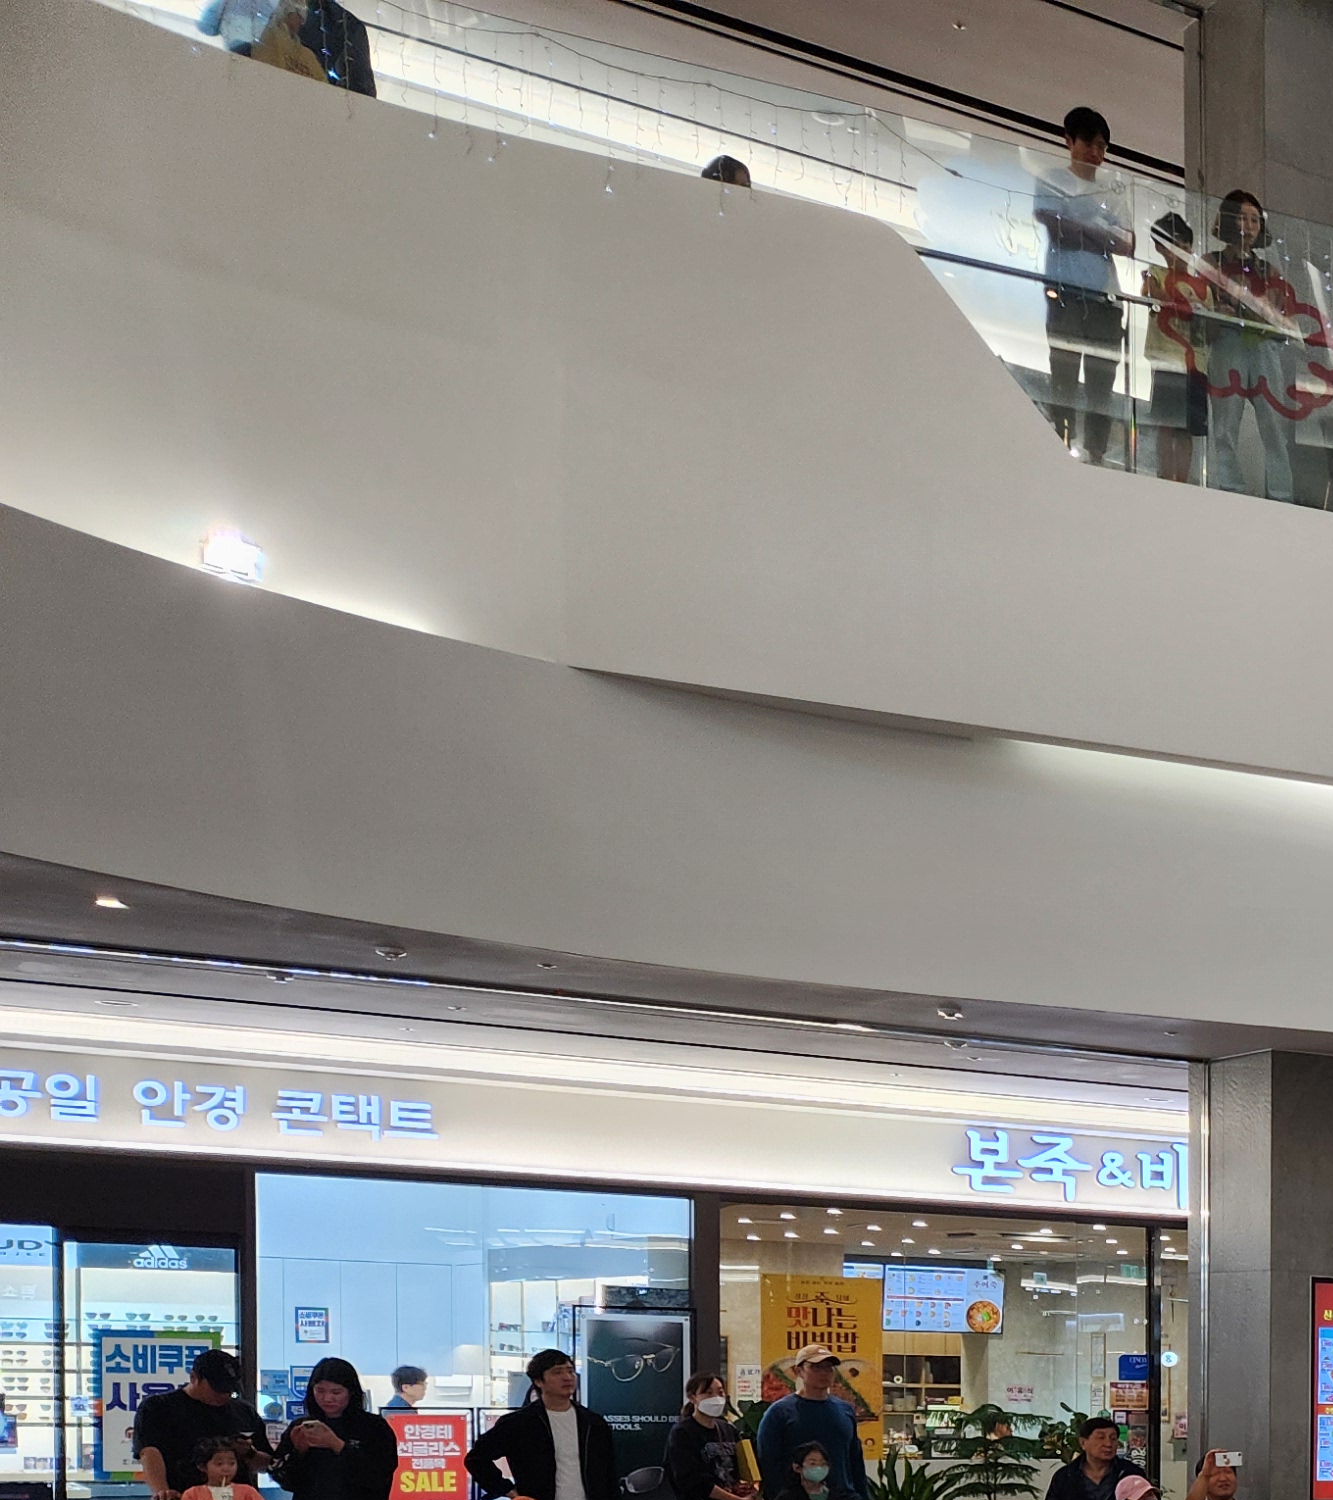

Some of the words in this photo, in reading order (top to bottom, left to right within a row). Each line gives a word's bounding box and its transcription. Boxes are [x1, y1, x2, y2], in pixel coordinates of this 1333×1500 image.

[133, 1079, 245, 1132] 안경
[271, 1088, 439, 1142] 콘택트
[133, 1258, 189, 1270] adidas
[786, 1306, 859, 1330] 맛나는
[602, 1415, 631, 1423] ASSES
[631, 1415, 667, 1423] SHOULD
[668, 1415, 680, 1423] BE
[611, 1423, 642, 1431] TOOLS.
[403, 1424, 453, 1440] 안경테
[397, 1441, 461, 1457] 선글라스
[400, 1471, 457, 1492] SALE
